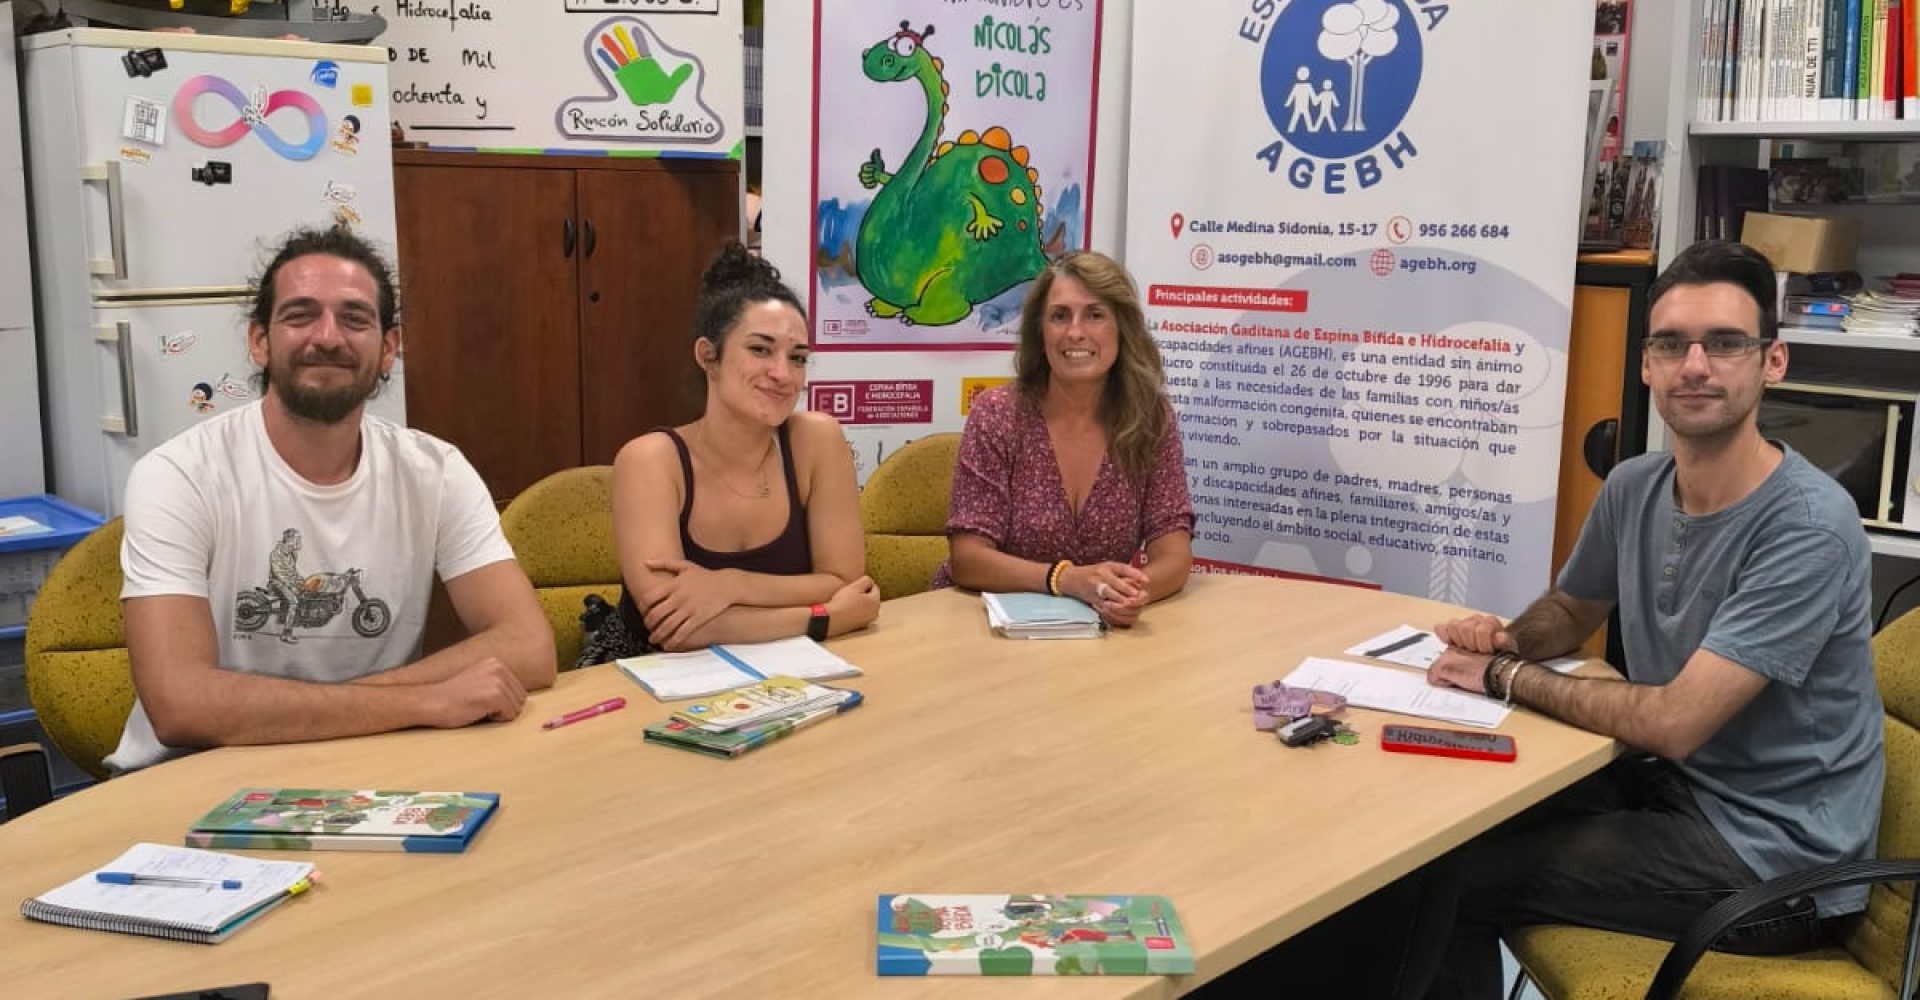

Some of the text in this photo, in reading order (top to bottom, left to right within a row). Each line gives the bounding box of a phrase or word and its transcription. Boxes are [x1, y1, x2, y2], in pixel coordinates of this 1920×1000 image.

[393, 83, 487, 119] ochenta y
[636, 109, 715, 134] Solidario
[1256, 131, 1417, 194] AGEBH
[1189, 220, 1223, 233] Calle
[1226, 221, 1275, 234] Medina
[1338, 223, 1378, 236] 15-17
[1419, 223, 1510, 239] 956 266 684
[1218, 252, 1357, 268] asogebh@gmail.com
[1400, 257, 1477, 274] agebh.org
[1155, 288, 1294, 307] Principales actividades:
[1161, 320, 1228, 335] Asociación
[1231, 323, 1290, 338] Gaditana
[1294, 328, 1310, 339] de
[1314, 328, 1359, 344] Espina
[1363, 331, 1405, 345] Bífida
[1408, 336, 1417, 346] e
[1420, 334, 1511, 352] Hidrocefalia
[1514, 343, 1526, 356] y
[1163, 356, 1522, 394] lucro constituida el 26 de octubre de 1996 para dar
[1236, 343, 1275, 356] afines
[1342, 351, 1356, 362] es
[1361, 353, 1386, 364] una
[1391, 353, 1446, 368] entidad
[1450, 356, 1471, 370] sin
[1476, 358, 1523, 374] ánimo
[1203, 379, 1210, 388] a
[1215, 377, 1231, 390] las
[1237, 382, 1314, 398] necesidades
[1320, 386, 1336, 399] de
[1341, 387, 1360, 401] las
[1366, 389, 1419, 406] familias
[1425, 397, 1453, 409] con
[1460, 397, 1519, 414] niños/as
[1193, 395, 1277, 412] malformación
[1352, 408, 1406, 425] quienes
[1409, 415, 1424, 426] se
[1427, 415, 1518, 435] encontraban
[1188, 431, 1241, 446] viviendo.
[1246, 420, 1254, 431] y
[1262, 419, 1350, 438] sobrepasados
[1359, 429, 1382, 442] por
[1391, 429, 1404, 443] la
[1414, 433, 1480, 450] situación
[1488, 442, 1516, 456] que
[1202, 460, 1218, 471] un
[1223, 461, 1265, 475] amplio
[1270, 466, 1308, 481] grupo
[1313, 469, 1329, 482] de
[1335, 472, 1381, 490] padres,
[1448, 486, 1512, 504] personas
[1191, 476, 1199, 488] y
[1203, 475, 1297, 497] discapacidades
[1349, 493, 1418, 513] familiares,
[1425, 503, 1497, 522] amigos/as
[1502, 513, 1511, 527] y
[1223, 496, 1294, 516] interesadas
[1297, 507, 1313, 518] en
[1316, 507, 1328, 520] la
[1331, 510, 1368, 524] plena
[1370, 515, 1449, 536] integración
[1453, 524, 1471, 538] de
[1475, 529, 1510, 544] estas
[1262, 520, 1273, 532] el
[1276, 520, 1321, 538] ámbito
[1369, 533, 1439, 556] educativo,
[1442, 544, 1507, 565] sanitario,
